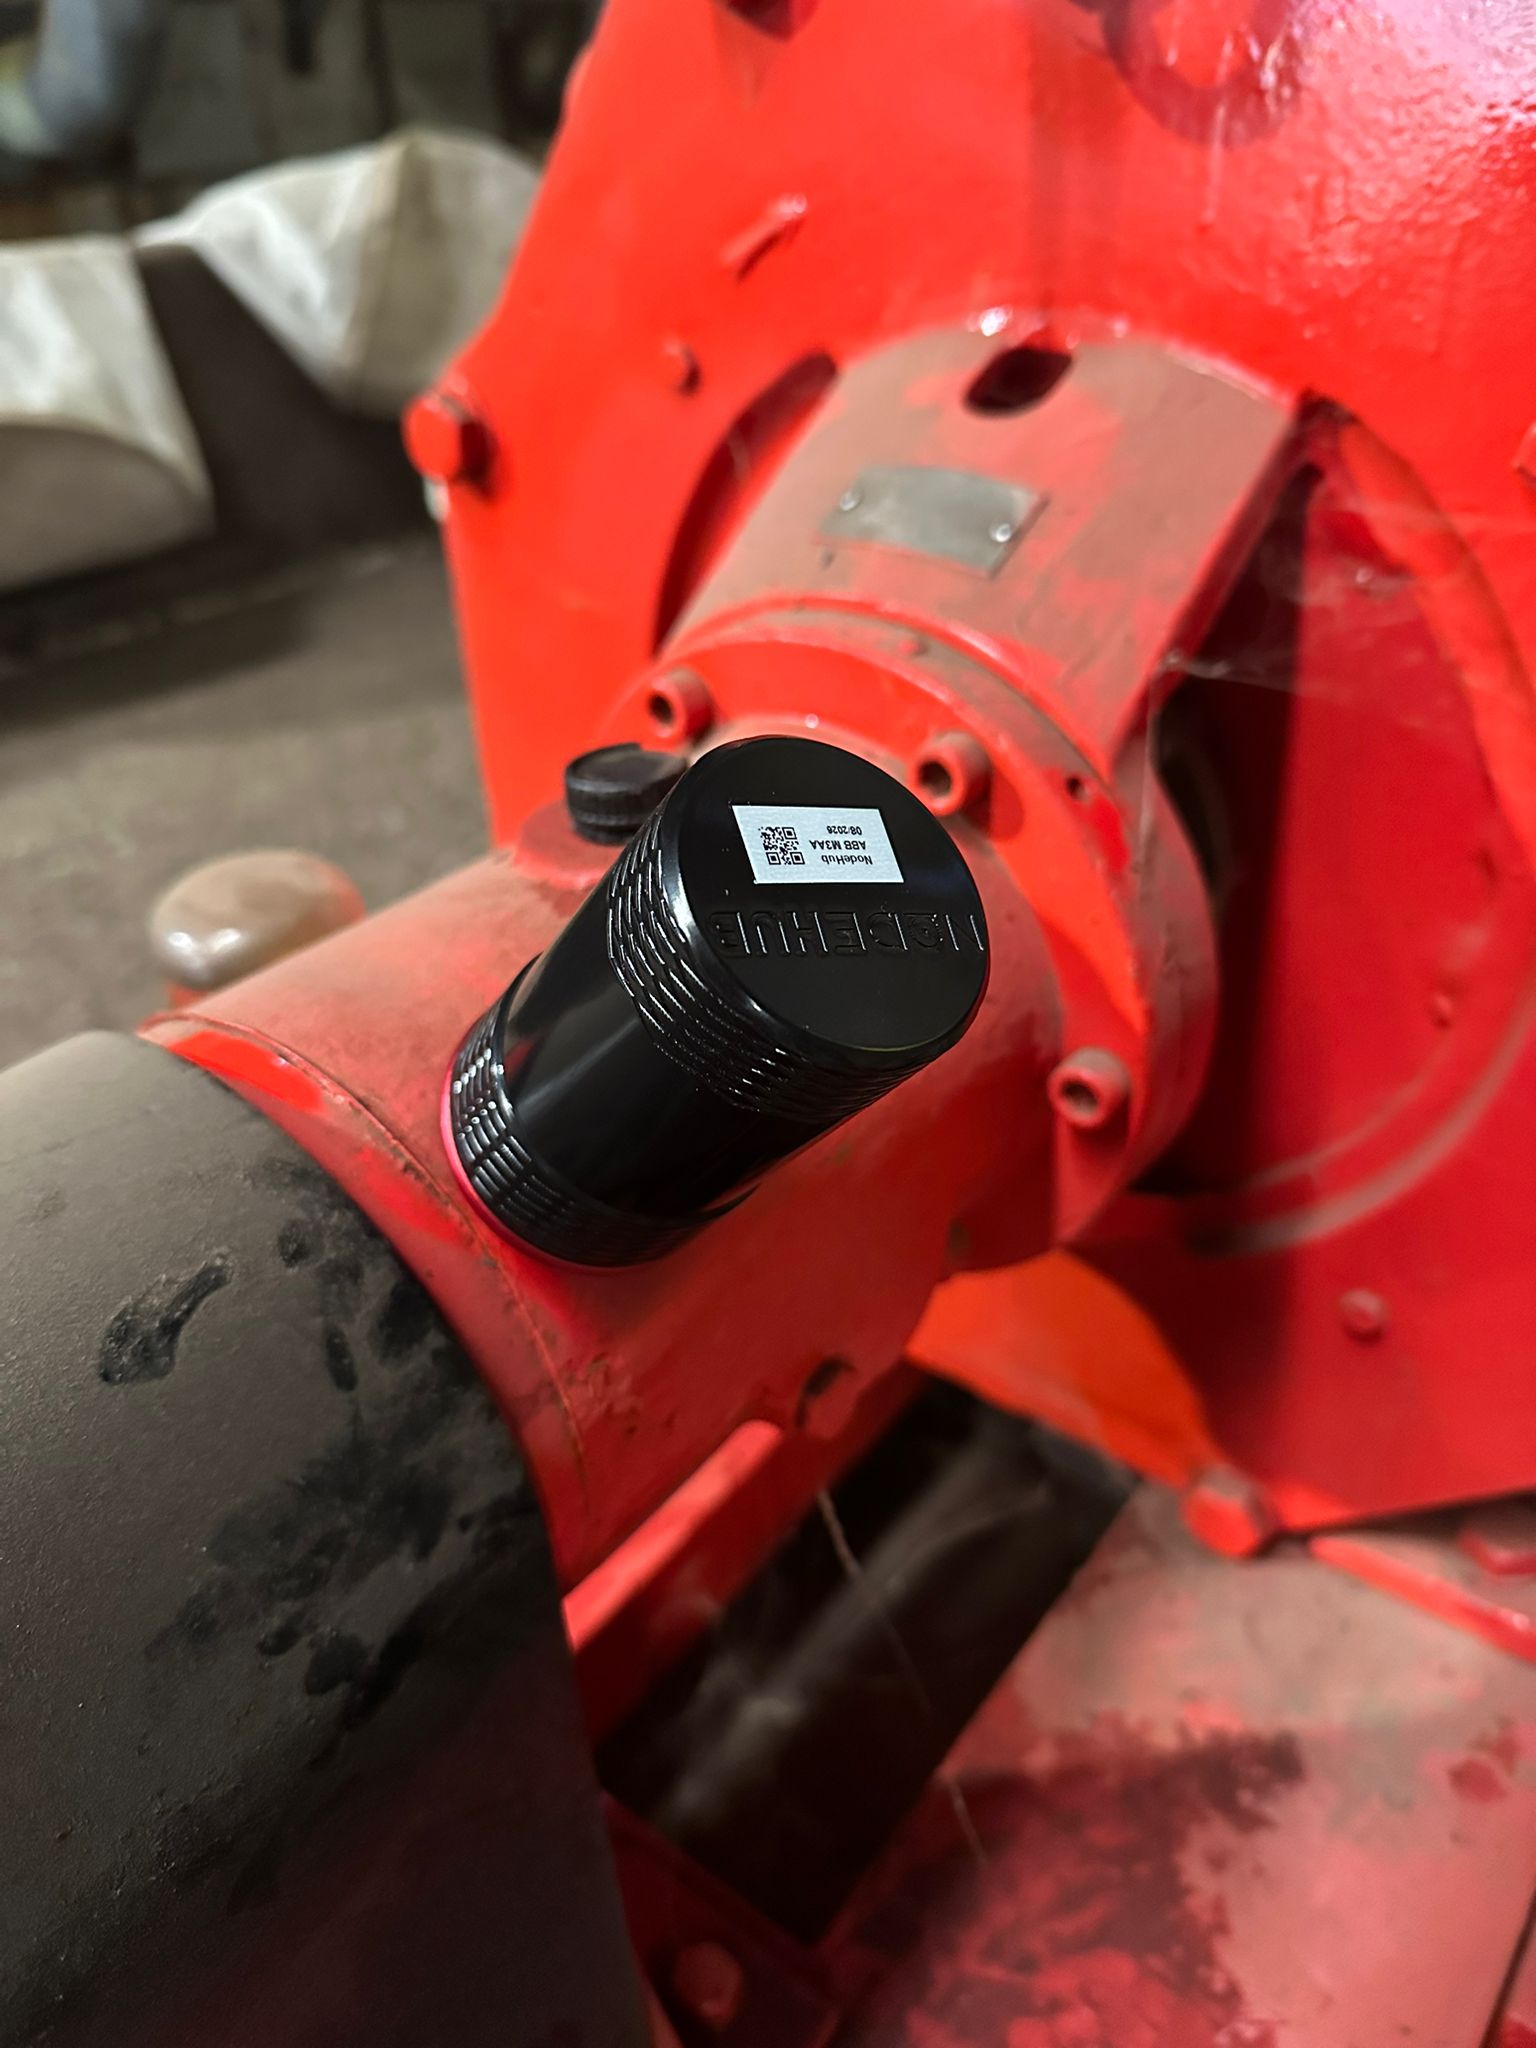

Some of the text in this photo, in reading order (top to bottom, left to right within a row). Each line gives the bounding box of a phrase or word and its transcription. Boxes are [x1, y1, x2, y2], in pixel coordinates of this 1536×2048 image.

[809, 840, 866, 850] ABB M3AA
[821, 855, 873, 865] NodeHub
[708, 911, 984, 957] NODEHUB
